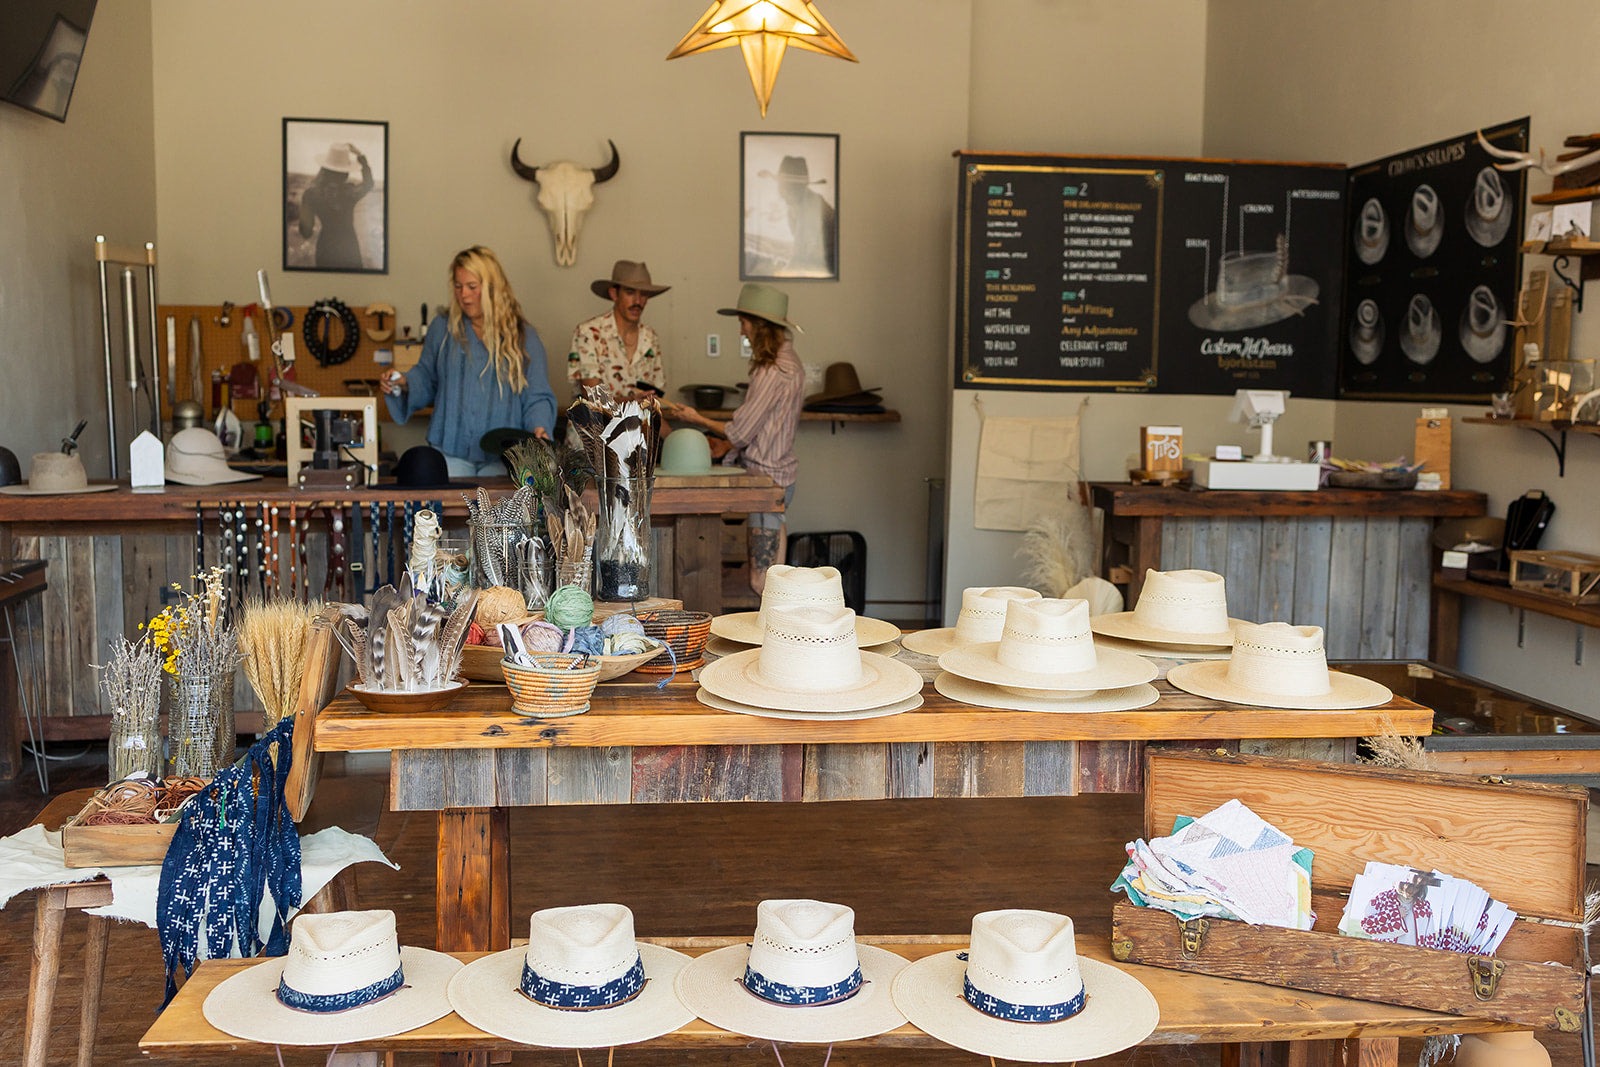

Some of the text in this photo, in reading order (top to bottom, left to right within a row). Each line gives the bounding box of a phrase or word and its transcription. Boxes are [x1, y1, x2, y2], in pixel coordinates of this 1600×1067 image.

[1005, 182, 1014, 196] 1
[1079, 182, 1088, 197] 2
[1002, 268, 1011, 280] 3
[1077, 288, 1086, 301] 4
[984, 307, 1011, 319] HIT THE
[984, 324, 1030, 335] WORKBENCH
[1061, 325, 1139, 338] Any Adjustments
[984, 340, 1017, 351] TO BUILD
[1060, 340, 1099, 352] CELEBRATE
[1200, 337, 1241, 356] Custom
[983, 356, 1018, 367] YOUR HAT
[1060, 356, 1079, 368] YOUR
[1147, 435, 1180, 461] TIPS
